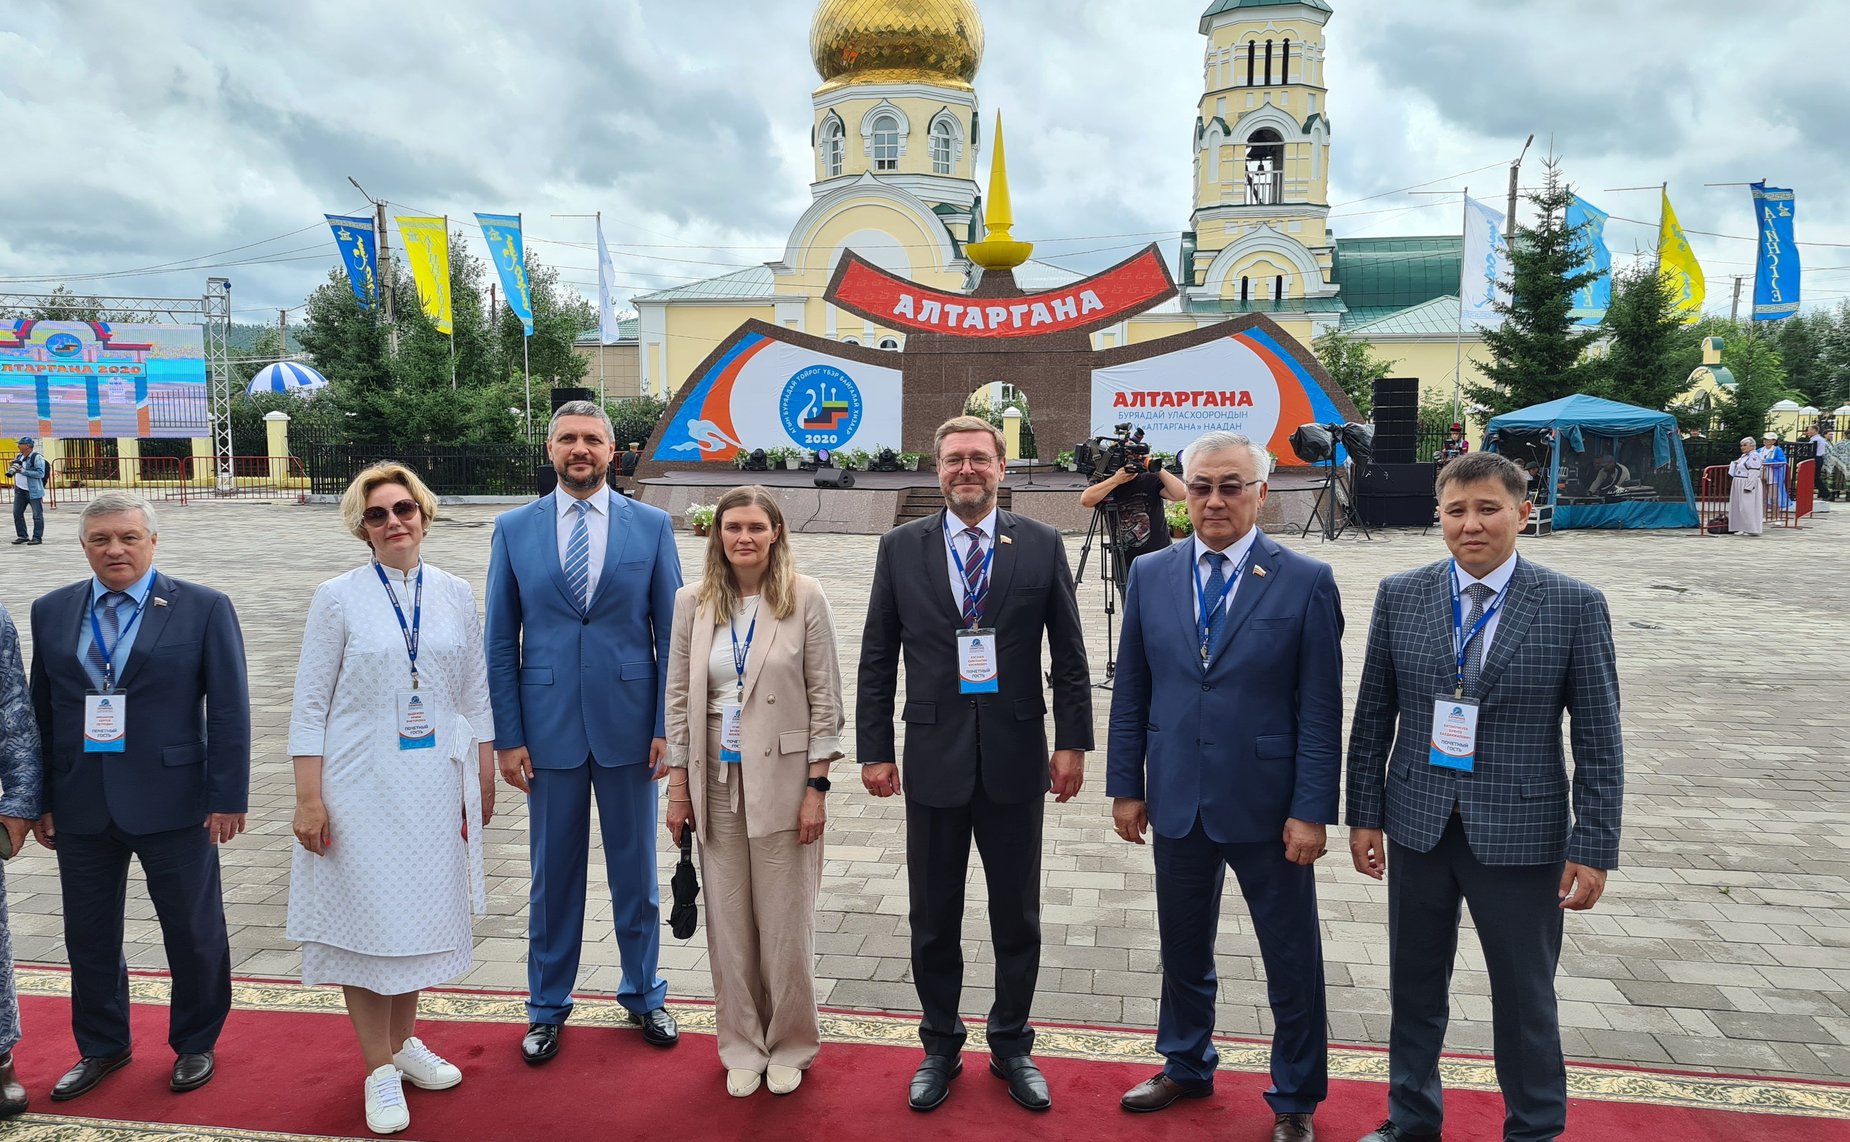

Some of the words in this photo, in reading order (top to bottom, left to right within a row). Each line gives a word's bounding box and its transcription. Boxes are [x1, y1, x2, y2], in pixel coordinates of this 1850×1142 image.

[893, 289, 1104, 329] АЛТАРГАНА
[796, 368, 821, 381] ТОЙРОГ
[783, 380, 798, 415] БУРЯАДАЙ
[839, 375, 860, 408] БАЙГАЛАЙ
[1113, 391, 1253, 408] АЛТАРГАНА
[846, 409, 859, 435] ХИЗААР
[1118, 410, 1165, 420] БУРЯАДАЙ
[1168, 410, 1248, 420] УЛАСХООРОНДЫН
[1142, 422, 1202, 431] «АЛТАРГАНА»
[1204, 422, 1242, 431] НААДАН
[805, 434, 838, 444] 2020
